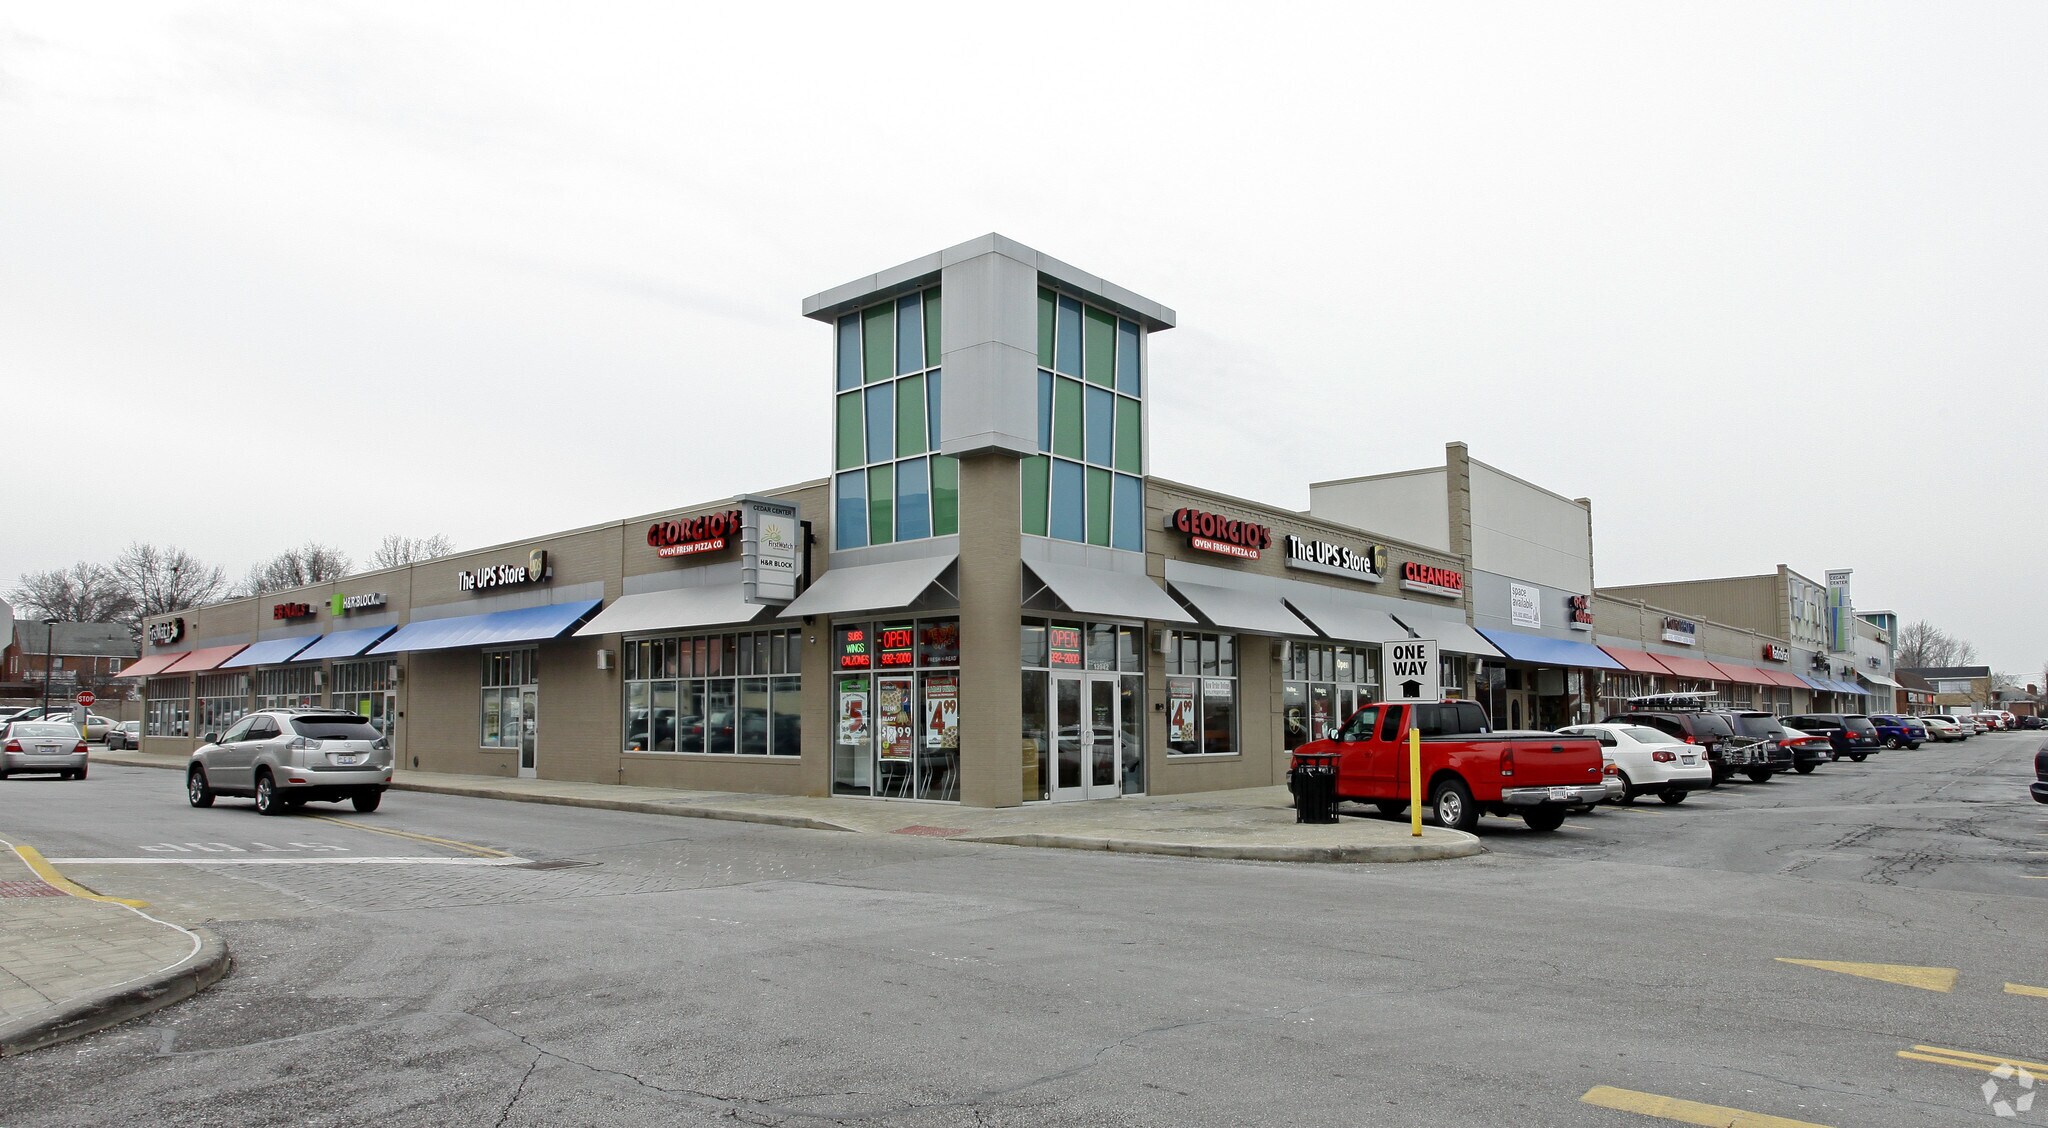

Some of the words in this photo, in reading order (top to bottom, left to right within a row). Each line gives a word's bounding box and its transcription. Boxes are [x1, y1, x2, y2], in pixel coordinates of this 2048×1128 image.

[753, 504, 772, 513] CEDAR
[772, 508, 792, 516] CENTER
[647, 511, 738, 547] GEORGIO'S
[1177, 507, 1272, 549] GEORGIO'S
[659, 547, 676, 557] OVEN
[676, 544, 694, 554] FRESH
[694, 541, 713, 551] PIZZA
[1194, 538, 1212, 550] OVEN
[1213, 542, 1231, 554] FRESH
[1231, 546, 1249, 558] PIZZA
[1289, 535, 1314, 562] The
[1316, 541, 1340, 567] UPS
[1342, 547, 1371, 574] Store
[760, 559, 773, 567] H&R
[774, 561, 793, 569] BLOCK
[458, 571, 475, 591] The
[477, 565, 497, 589] UPS
[498, 564, 525, 585] Store
[1405, 561, 1462, 590] CLEANERS
[1512, 587, 1527, 598] space
[355, 594, 377, 607] BLOCK
[1512, 598, 1533, 610] available
[847, 630, 864, 642] SUBS
[883, 630, 911, 648] OPEN
[1052, 630, 1079, 648] OPEN
[846, 643, 865, 654] WINGS
[1393, 645, 1425, 660] ONE
[841, 654, 870, 667] CALZONES
[881, 652, 912, 664] 932-2000
[1393, 661, 1428, 676] WAY
